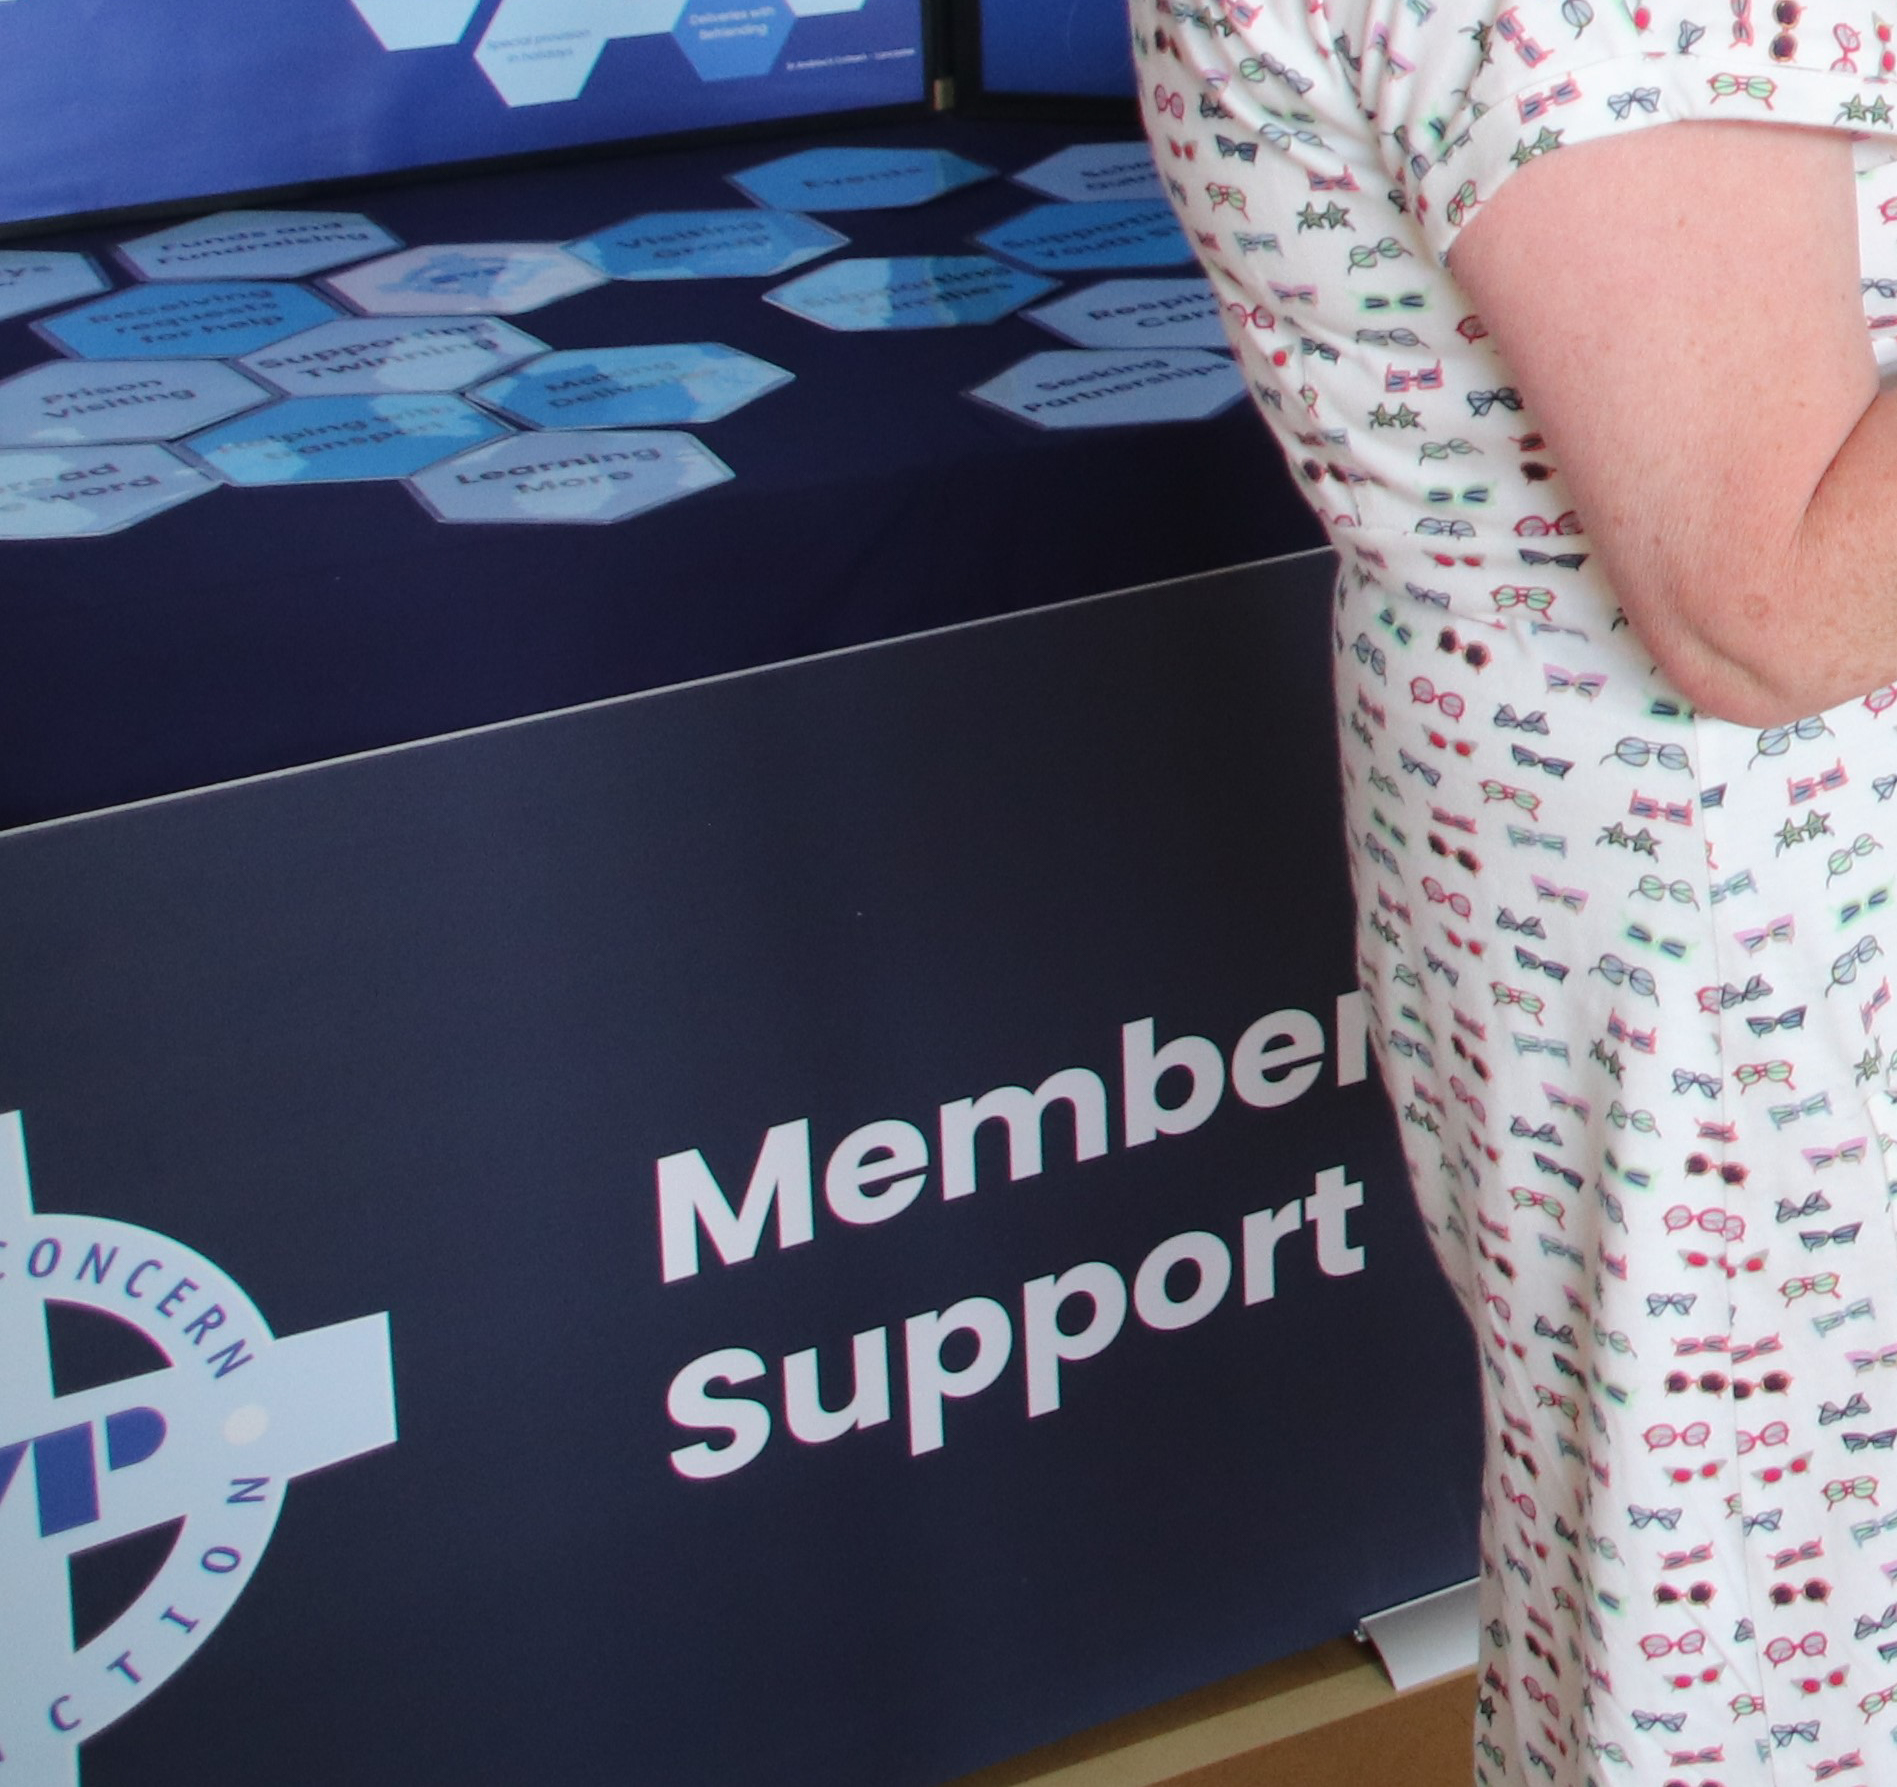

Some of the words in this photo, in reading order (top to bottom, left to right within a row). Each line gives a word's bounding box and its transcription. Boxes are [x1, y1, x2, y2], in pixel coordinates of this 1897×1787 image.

[801, 166, 923, 190] Events
[157, 231, 369, 265] Fundraising
[161, 229, 266, 252] Funds
[275, 220, 343, 236] and
[616, 218, 767, 251] Visiting
[652, 234, 771, 259] Group
[89, 287, 274, 324] Receiving
[116, 300, 280, 335] requests
[140, 328, 192, 345] for
[200, 313, 284, 336] help
[1023, 363, 1230, 412] Partnerships
[1037, 359, 1169, 391] Seeking
[42, 378, 163, 406] Prison
[44, 387, 197, 420] Visiting
[455, 445, 663, 486] Learning
[515, 469, 634, 495] More
[656, 987, 1372, 1283] Member
[0, 1236, 254, 1379] ONCERN
[664, 1163, 1366, 1482] Support
[2, 1474, 272, 1759] CTION
